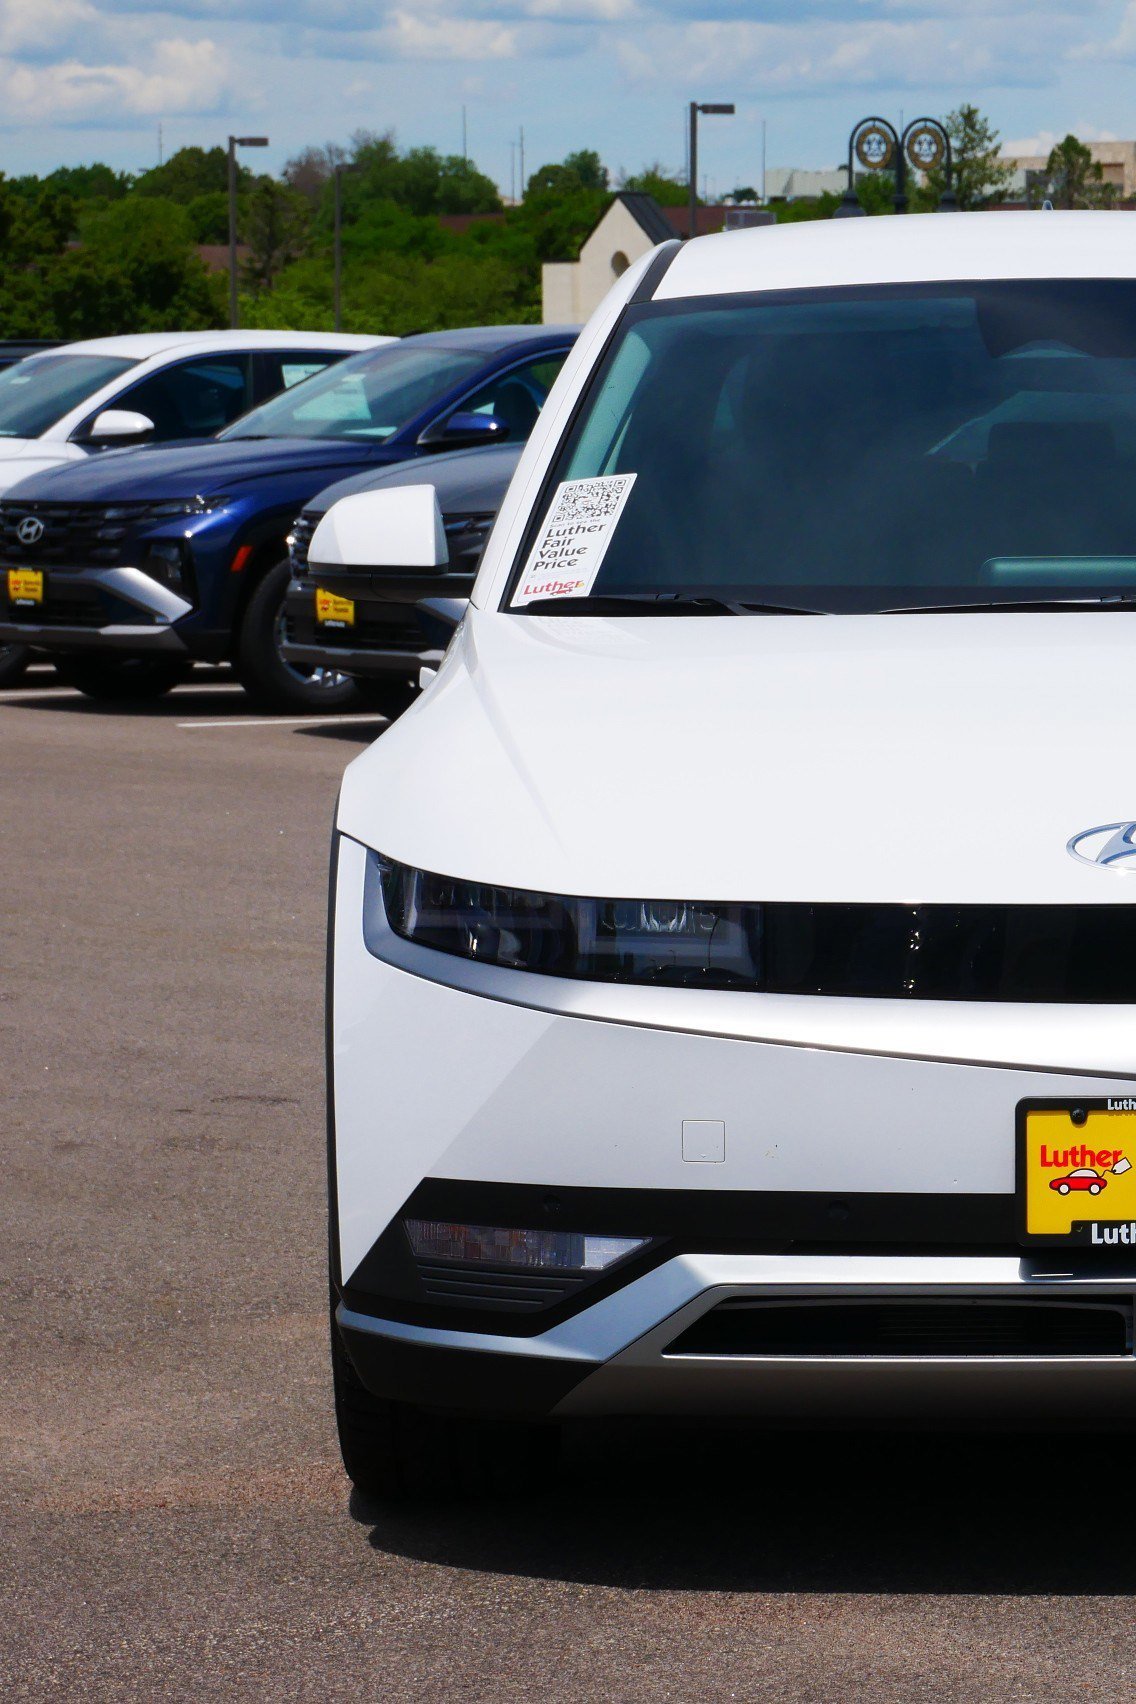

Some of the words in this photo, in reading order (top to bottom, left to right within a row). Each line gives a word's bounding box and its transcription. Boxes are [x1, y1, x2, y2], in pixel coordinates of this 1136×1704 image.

[546, 523, 606, 538] Luther
[541, 537, 574, 549] Fair
[538, 546, 588, 559] Value
[533, 558, 578, 571] Price
[523, 580, 584, 595] Luther
[1040, 1145, 1122, 1168] Luther
